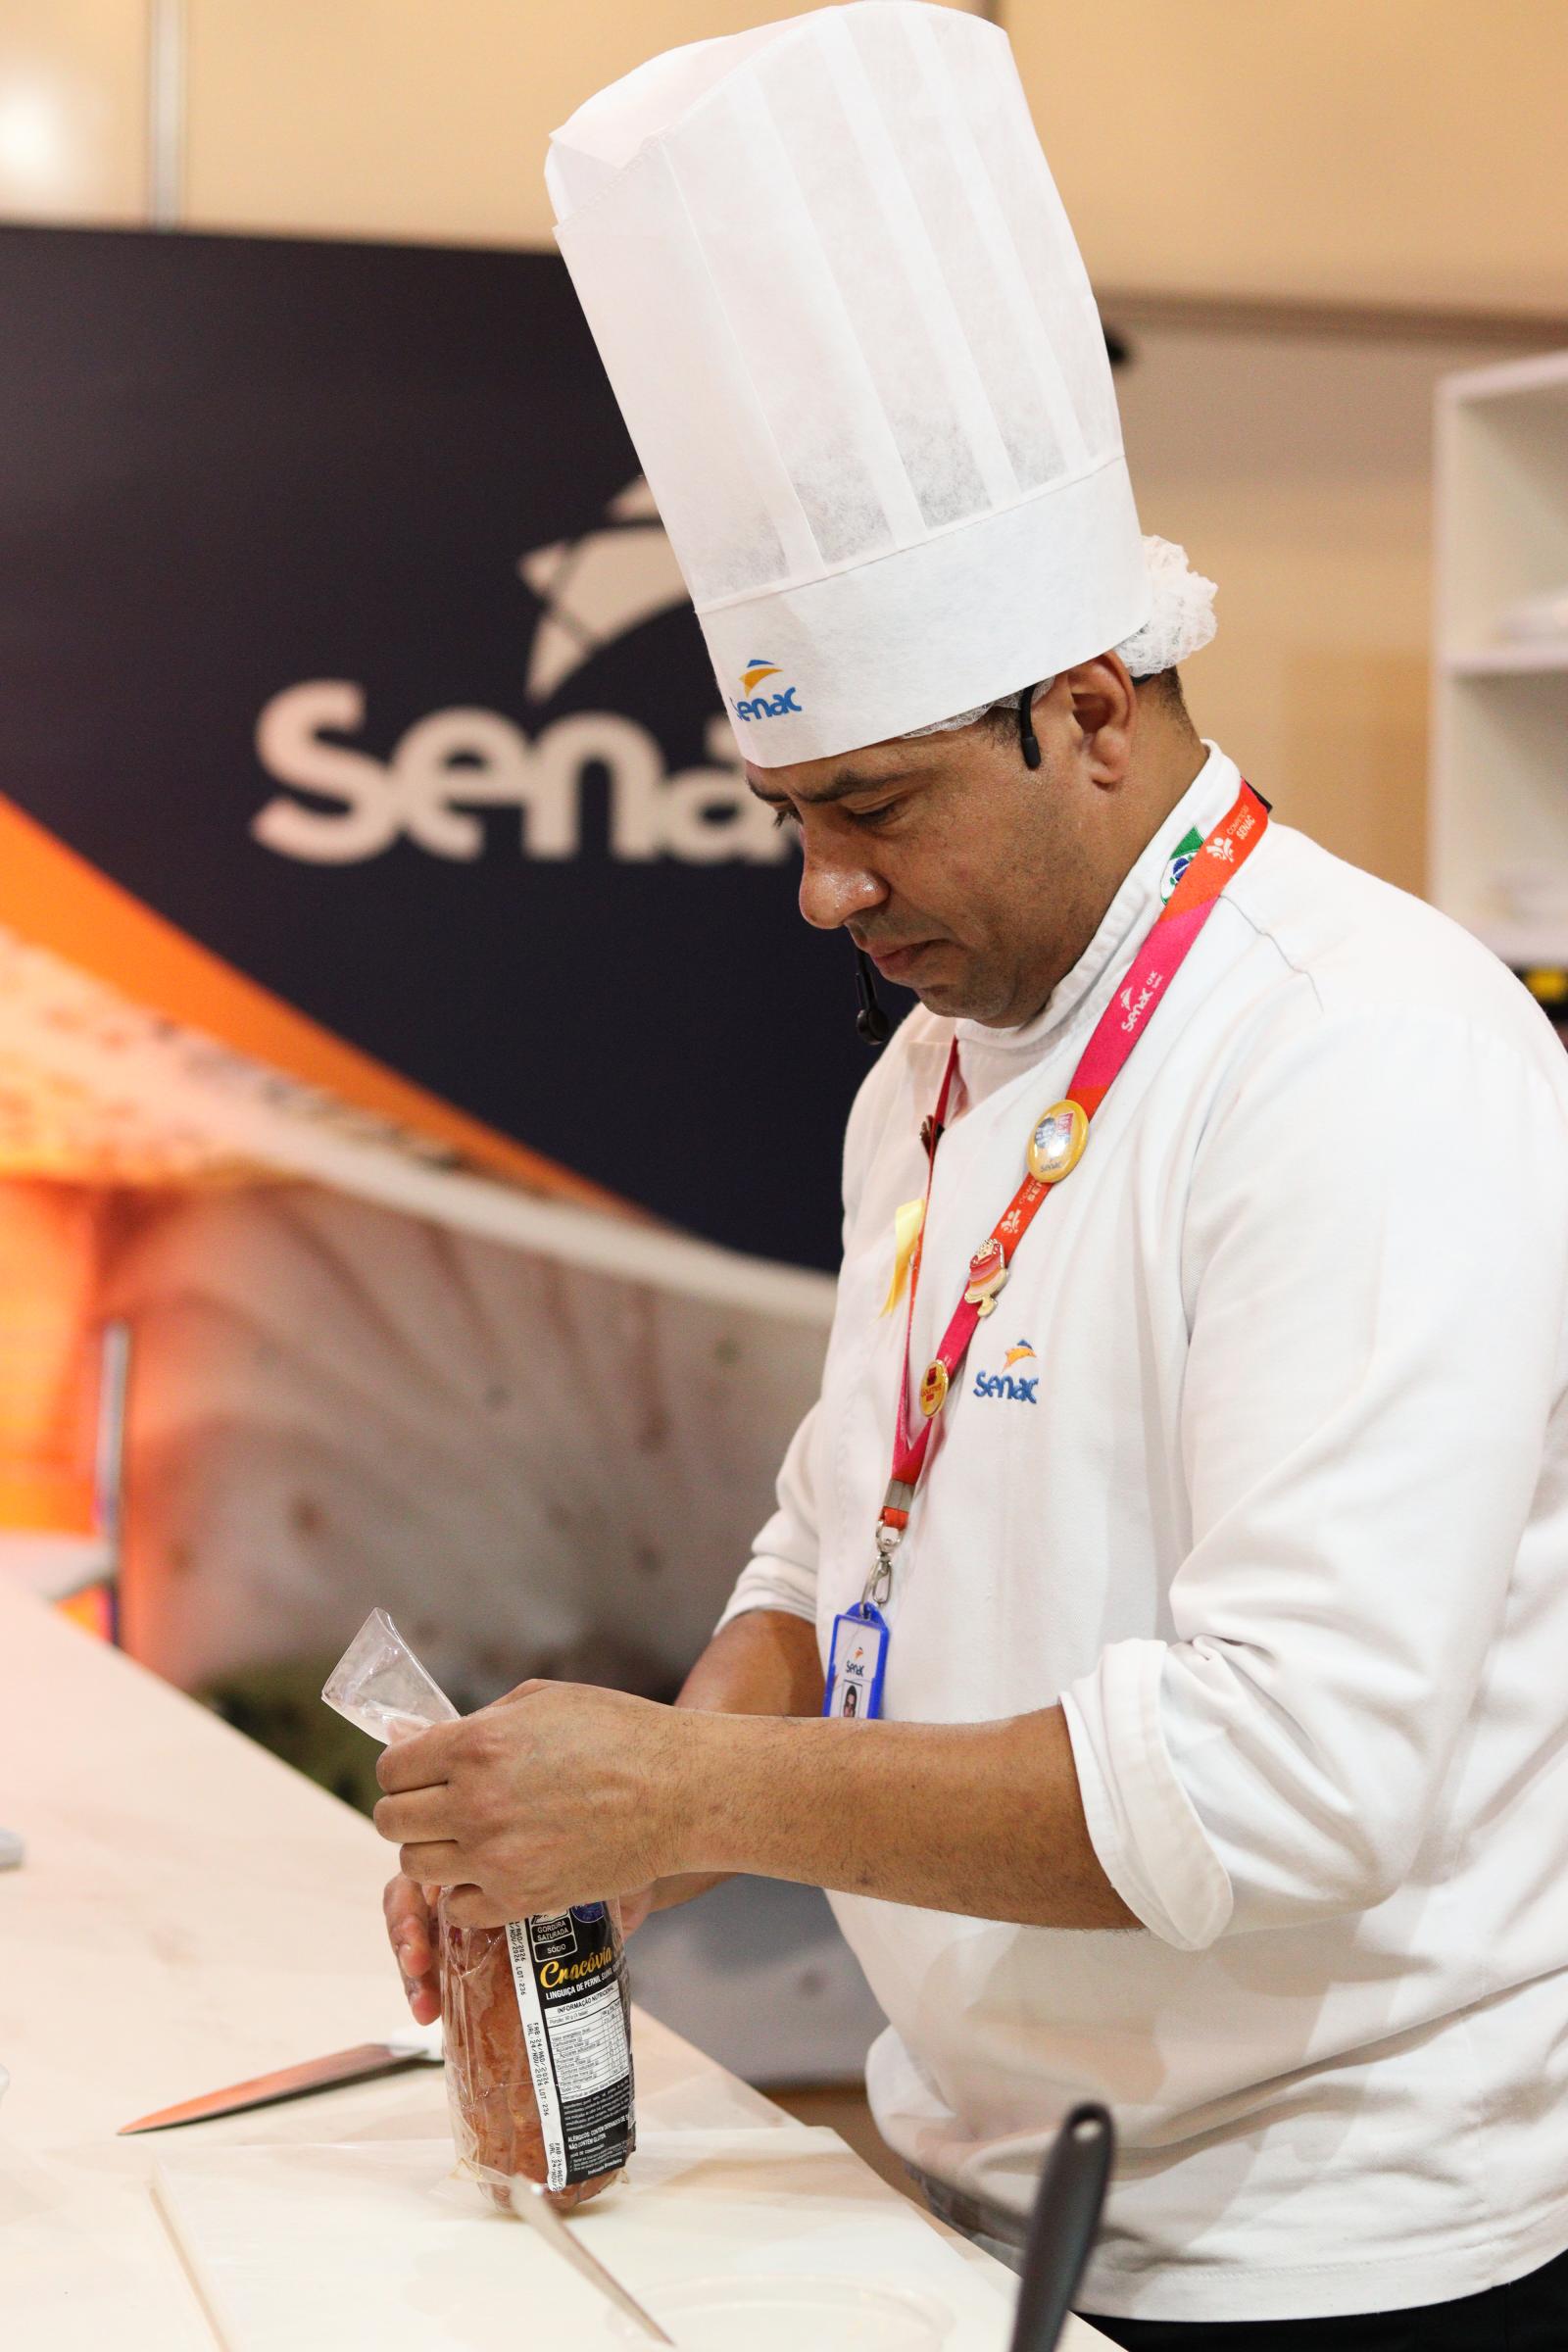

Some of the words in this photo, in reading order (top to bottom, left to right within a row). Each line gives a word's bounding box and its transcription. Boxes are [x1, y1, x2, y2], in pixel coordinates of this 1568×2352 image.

[252, 678, 792, 866] Sena
[1120, 987, 1154, 1033] Senac
[973, 1369, 1040, 1404] Senac
[537, 1920, 566, 1934] GORDURA
[537, 1928, 569, 1942] SATURADA
[547, 1943, 566, 1954] SÓDIO
[540, 1946, 612, 1988] Cracóvia
[546, 1986, 576, 2001] LINGUIÇA
[576, 1983, 585, 1992] DE
[584, 1975, 601, 1990] PERNIL
[557, 1996, 591, 2014] INFORMAÇÃO
